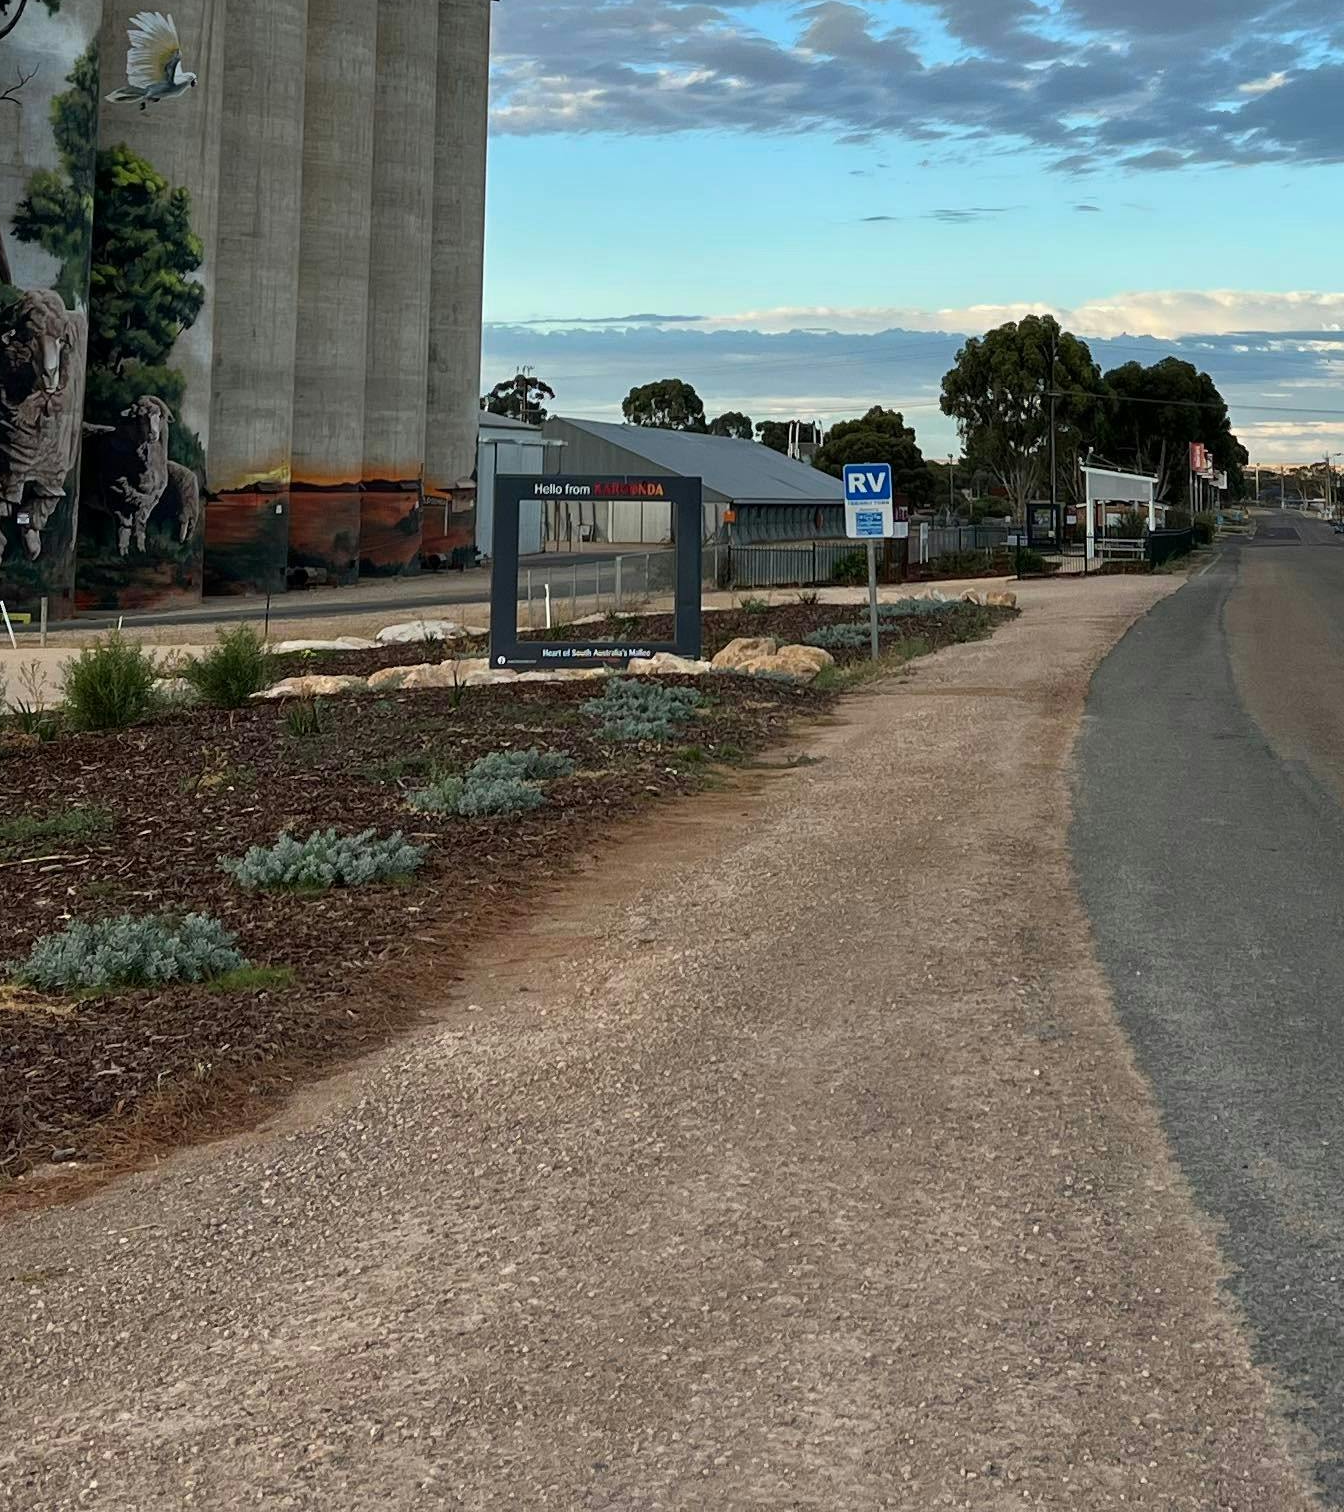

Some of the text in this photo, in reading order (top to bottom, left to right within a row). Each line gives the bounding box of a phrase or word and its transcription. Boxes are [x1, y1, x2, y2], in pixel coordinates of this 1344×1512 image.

[848, 472, 886, 493] RV
[534, 483, 562, 495] Hello
[565, 483, 590, 495] from
[542, 649, 561, 657] Heart
